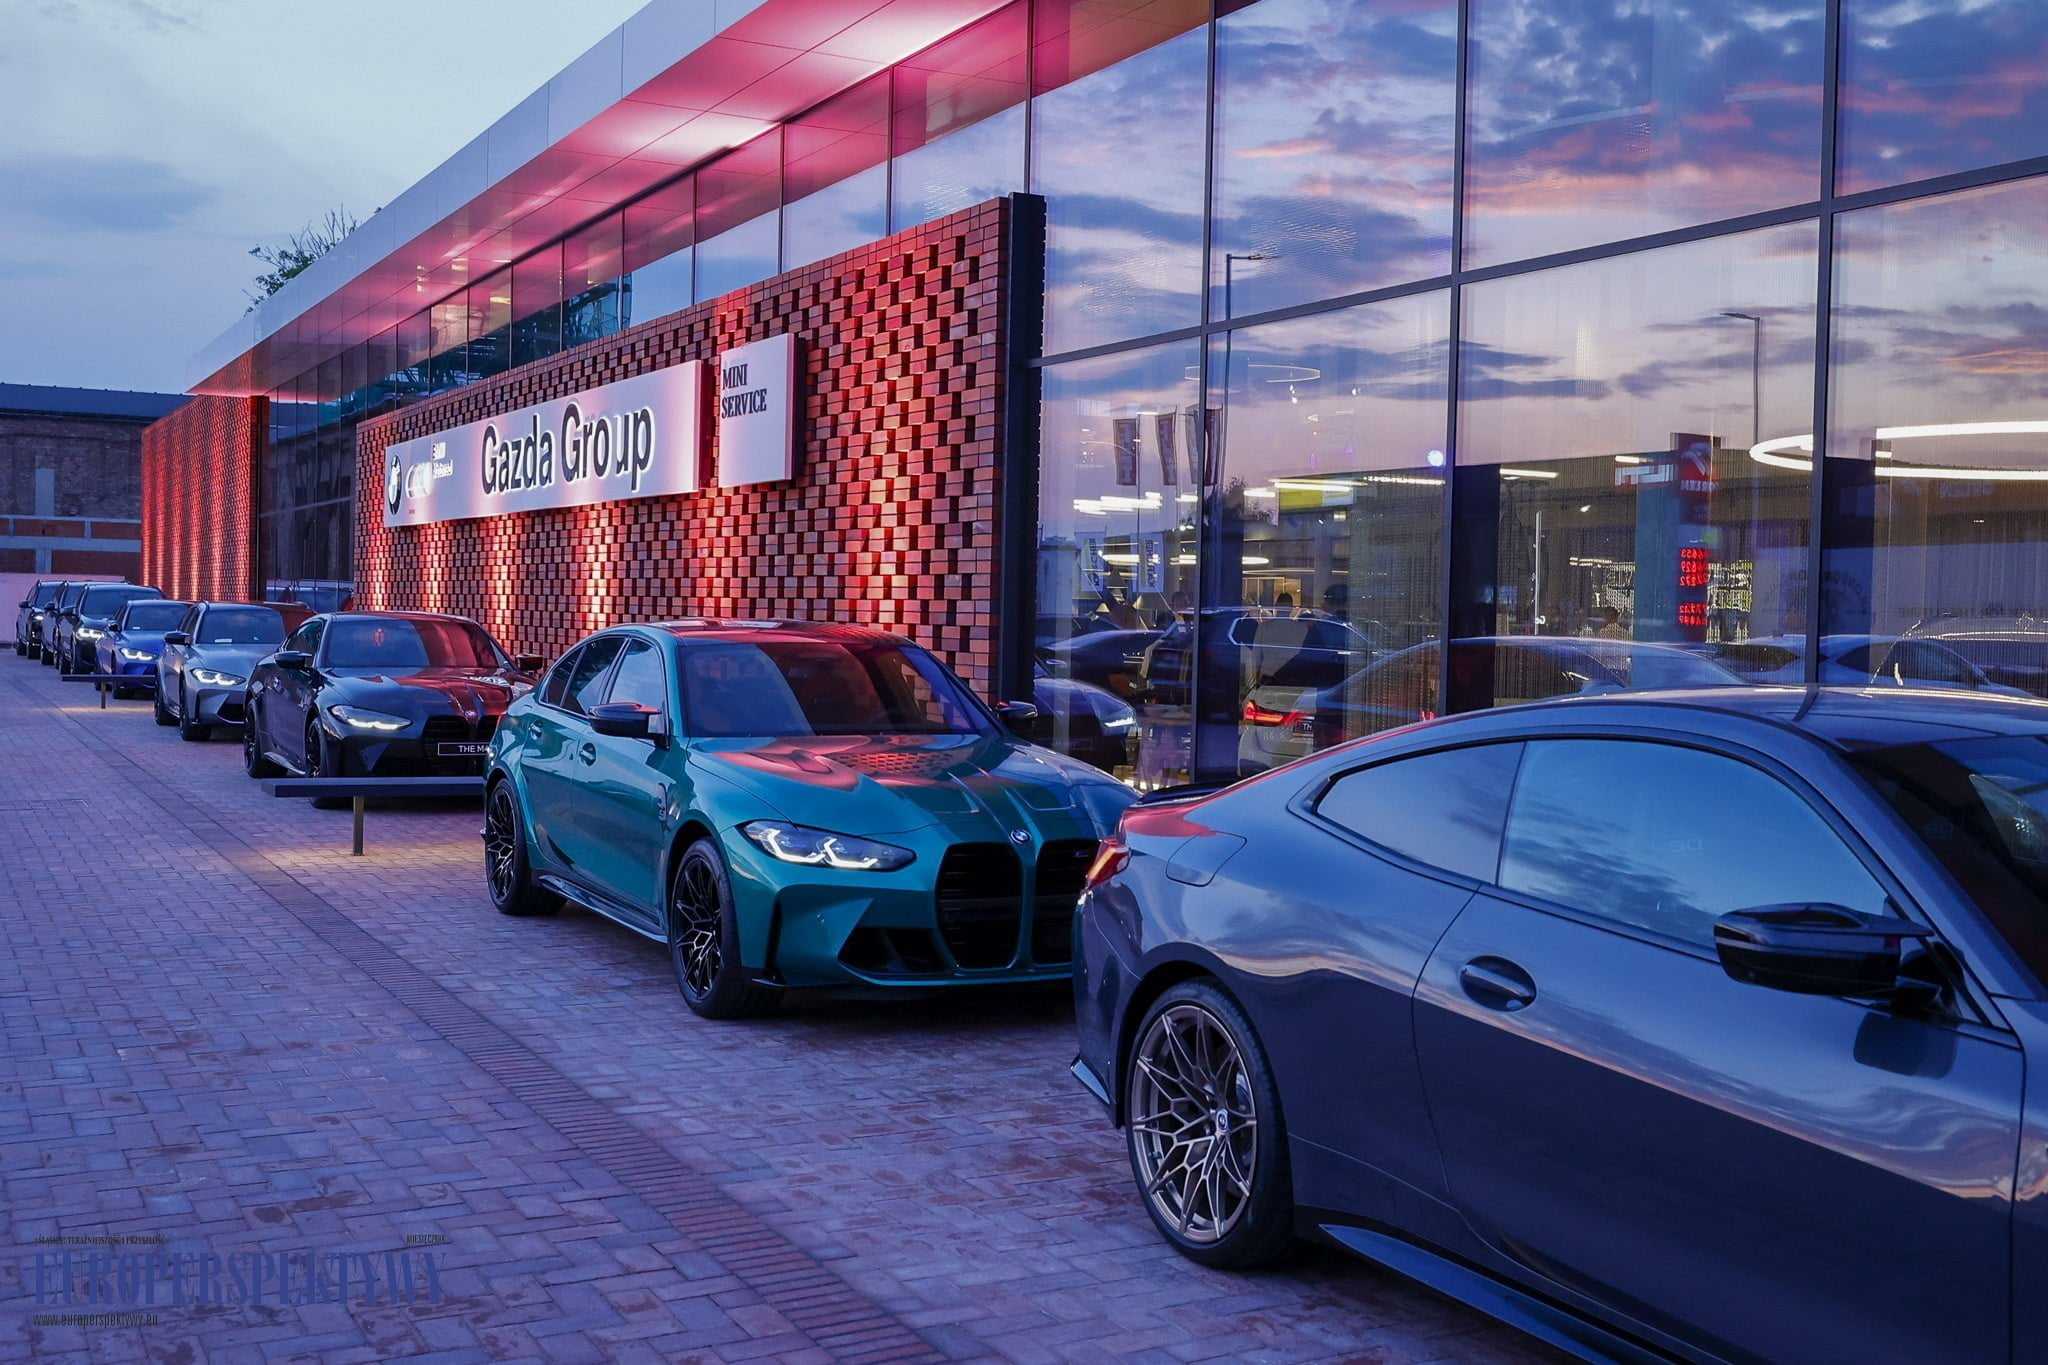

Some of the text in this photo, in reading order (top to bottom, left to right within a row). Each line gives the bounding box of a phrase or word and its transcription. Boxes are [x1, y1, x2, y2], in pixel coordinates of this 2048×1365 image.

[722, 363, 748, 390] MINI
[721, 388, 767, 419] SERVICE
[481, 402, 653, 496] Gazda Group
